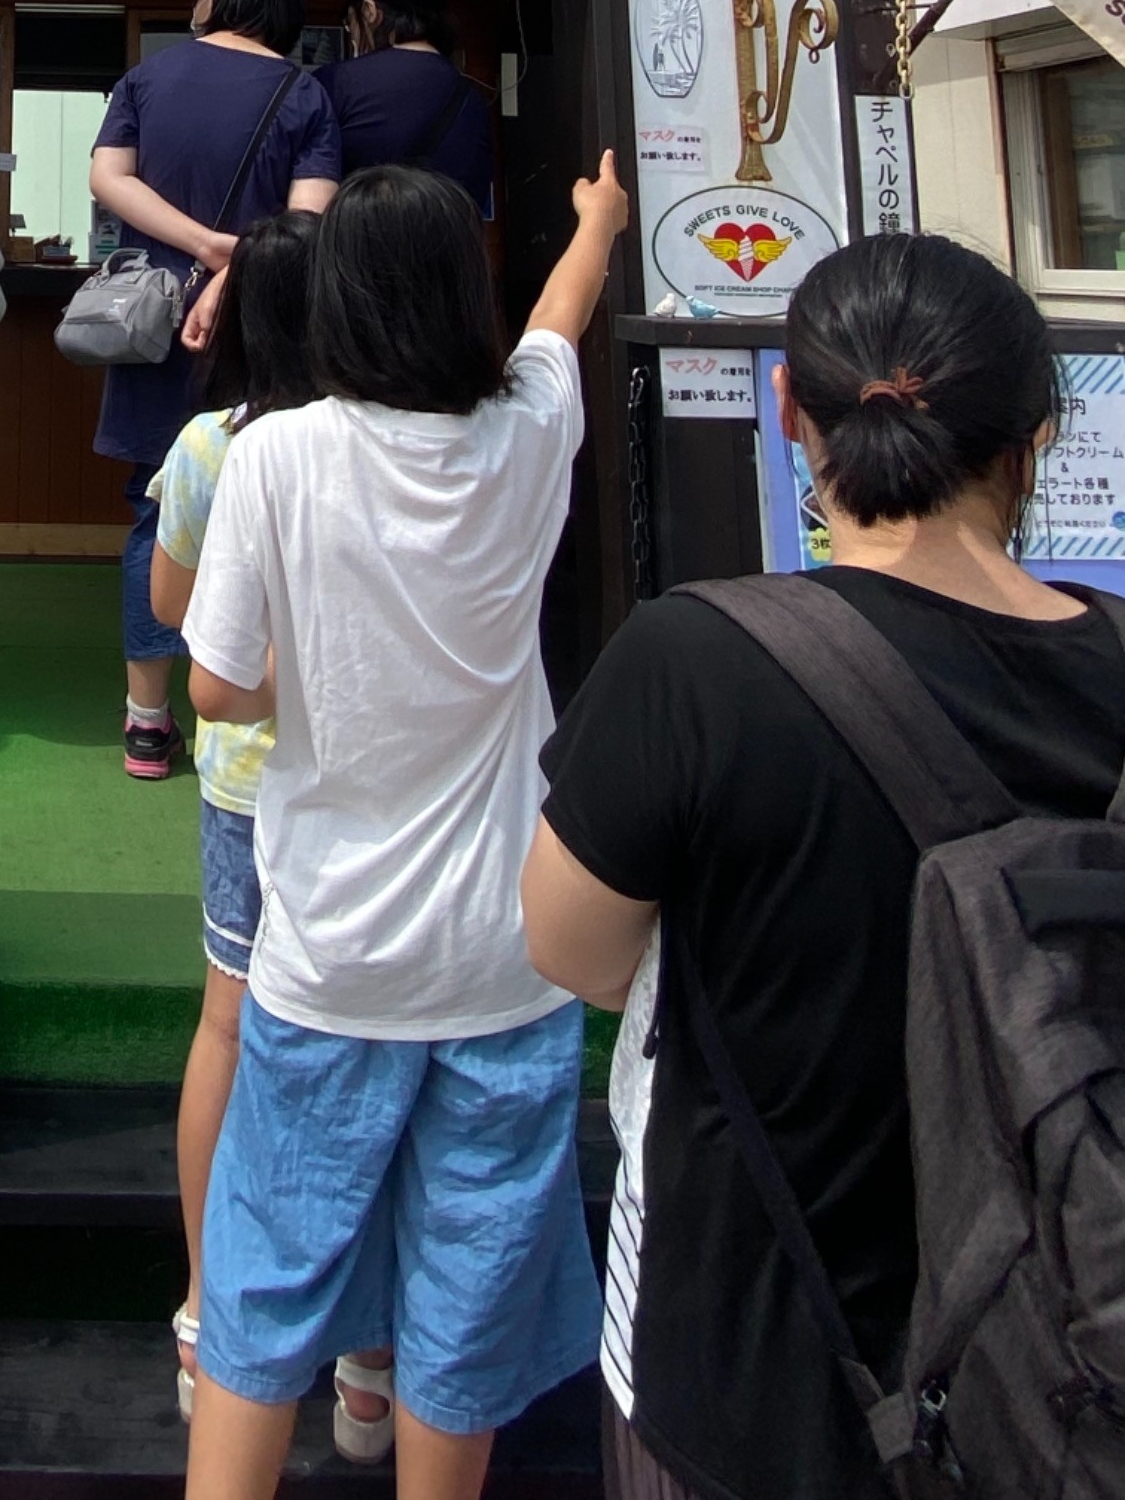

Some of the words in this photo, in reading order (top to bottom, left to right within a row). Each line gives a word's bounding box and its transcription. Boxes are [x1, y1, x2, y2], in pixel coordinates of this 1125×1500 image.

[638, 129, 675, 143] マスク
[871, 101, 900, 236] チャペルの鐘
[683, 205, 731, 238] SWEETS
[736, 204, 768, 219] GIVE
[772, 211, 806, 240] LOVE
[665, 357, 718, 376] マスク
[668, 389, 752, 402] お願い致します。
